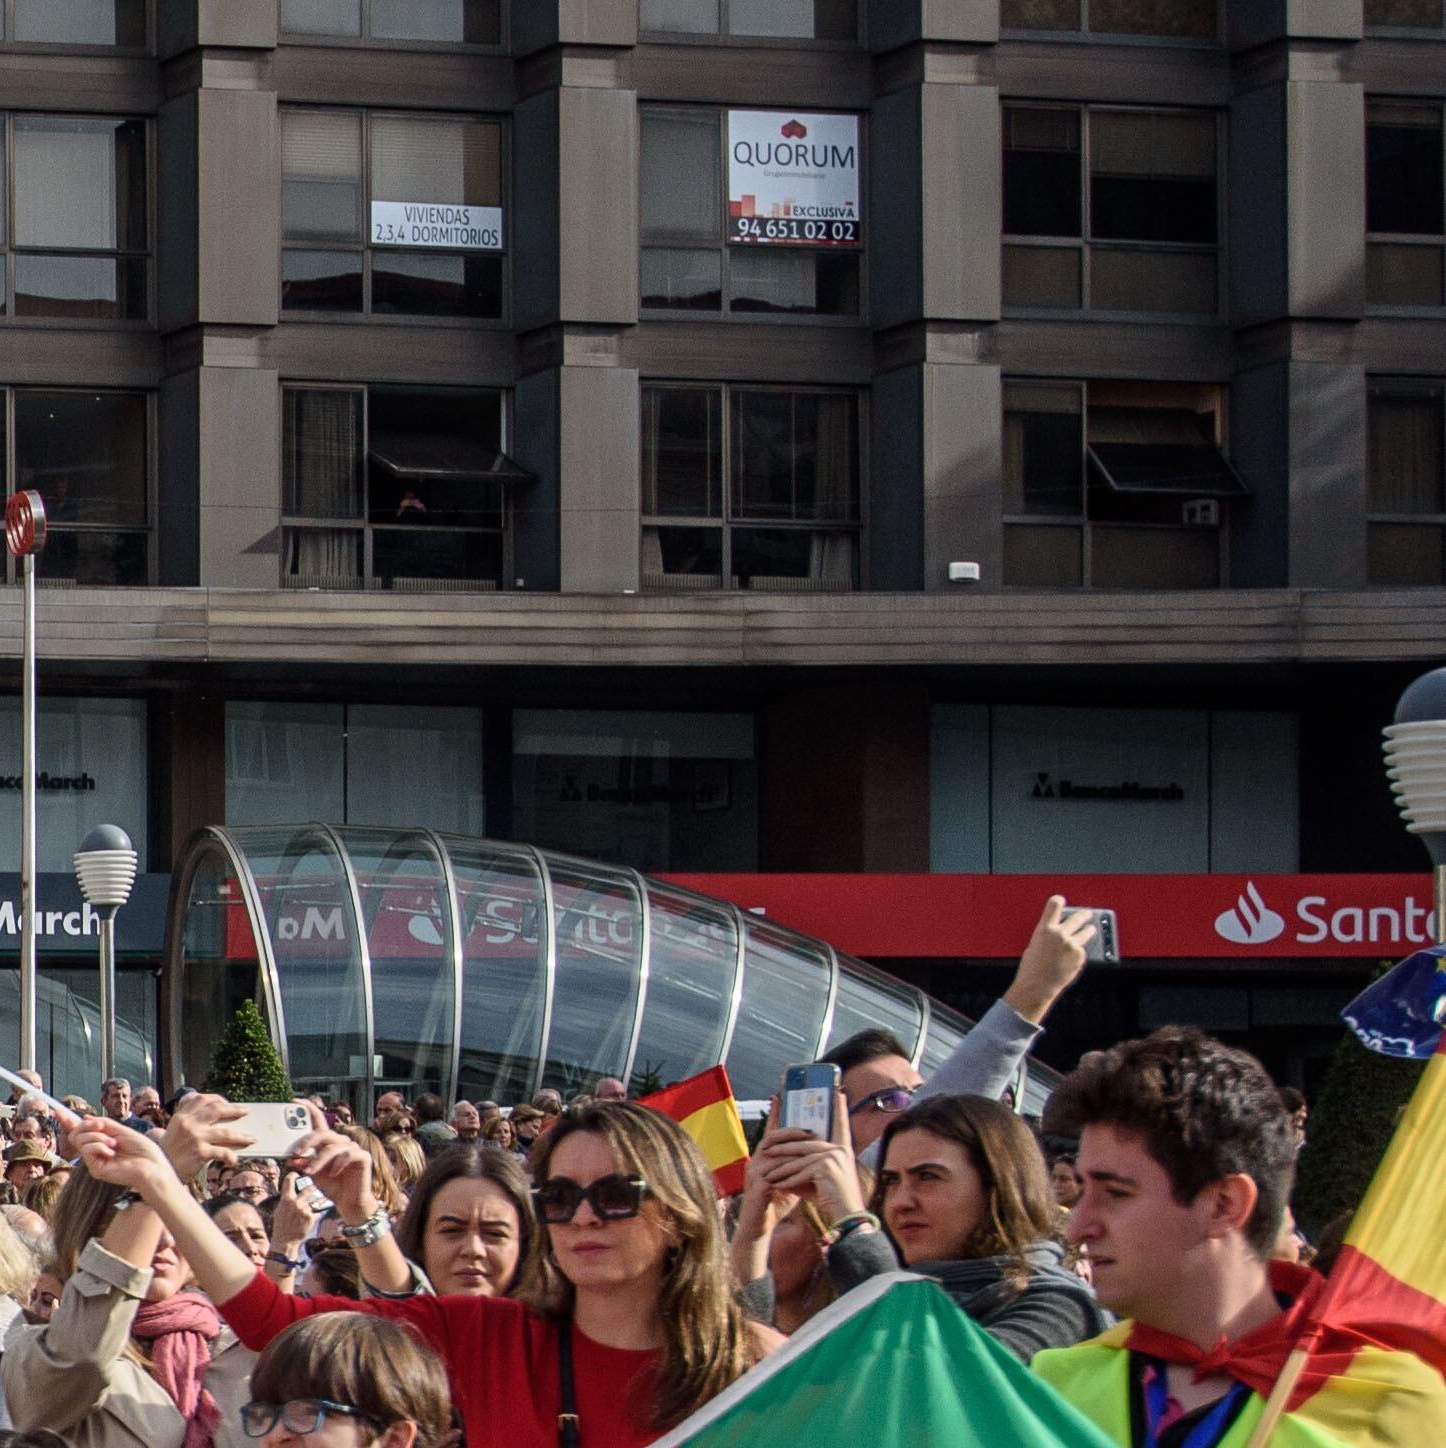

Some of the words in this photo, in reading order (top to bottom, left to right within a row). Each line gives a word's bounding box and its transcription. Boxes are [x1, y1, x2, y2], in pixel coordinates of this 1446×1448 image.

[733, 141, 855, 169] QUORUM
[404, 206, 470, 226] VIVIENDAS
[792, 205, 855, 218] EXCLUSIVA
[376, 223, 405, 243] 2,3,4
[412, 225, 499, 246] DORMITORIOS
[738, 218, 761, 237] 94
[765, 219, 800, 239] 651
[804, 221, 827, 240] 02
[832, 222, 854, 241] 02
[1296, 896, 1435, 943] Sant
